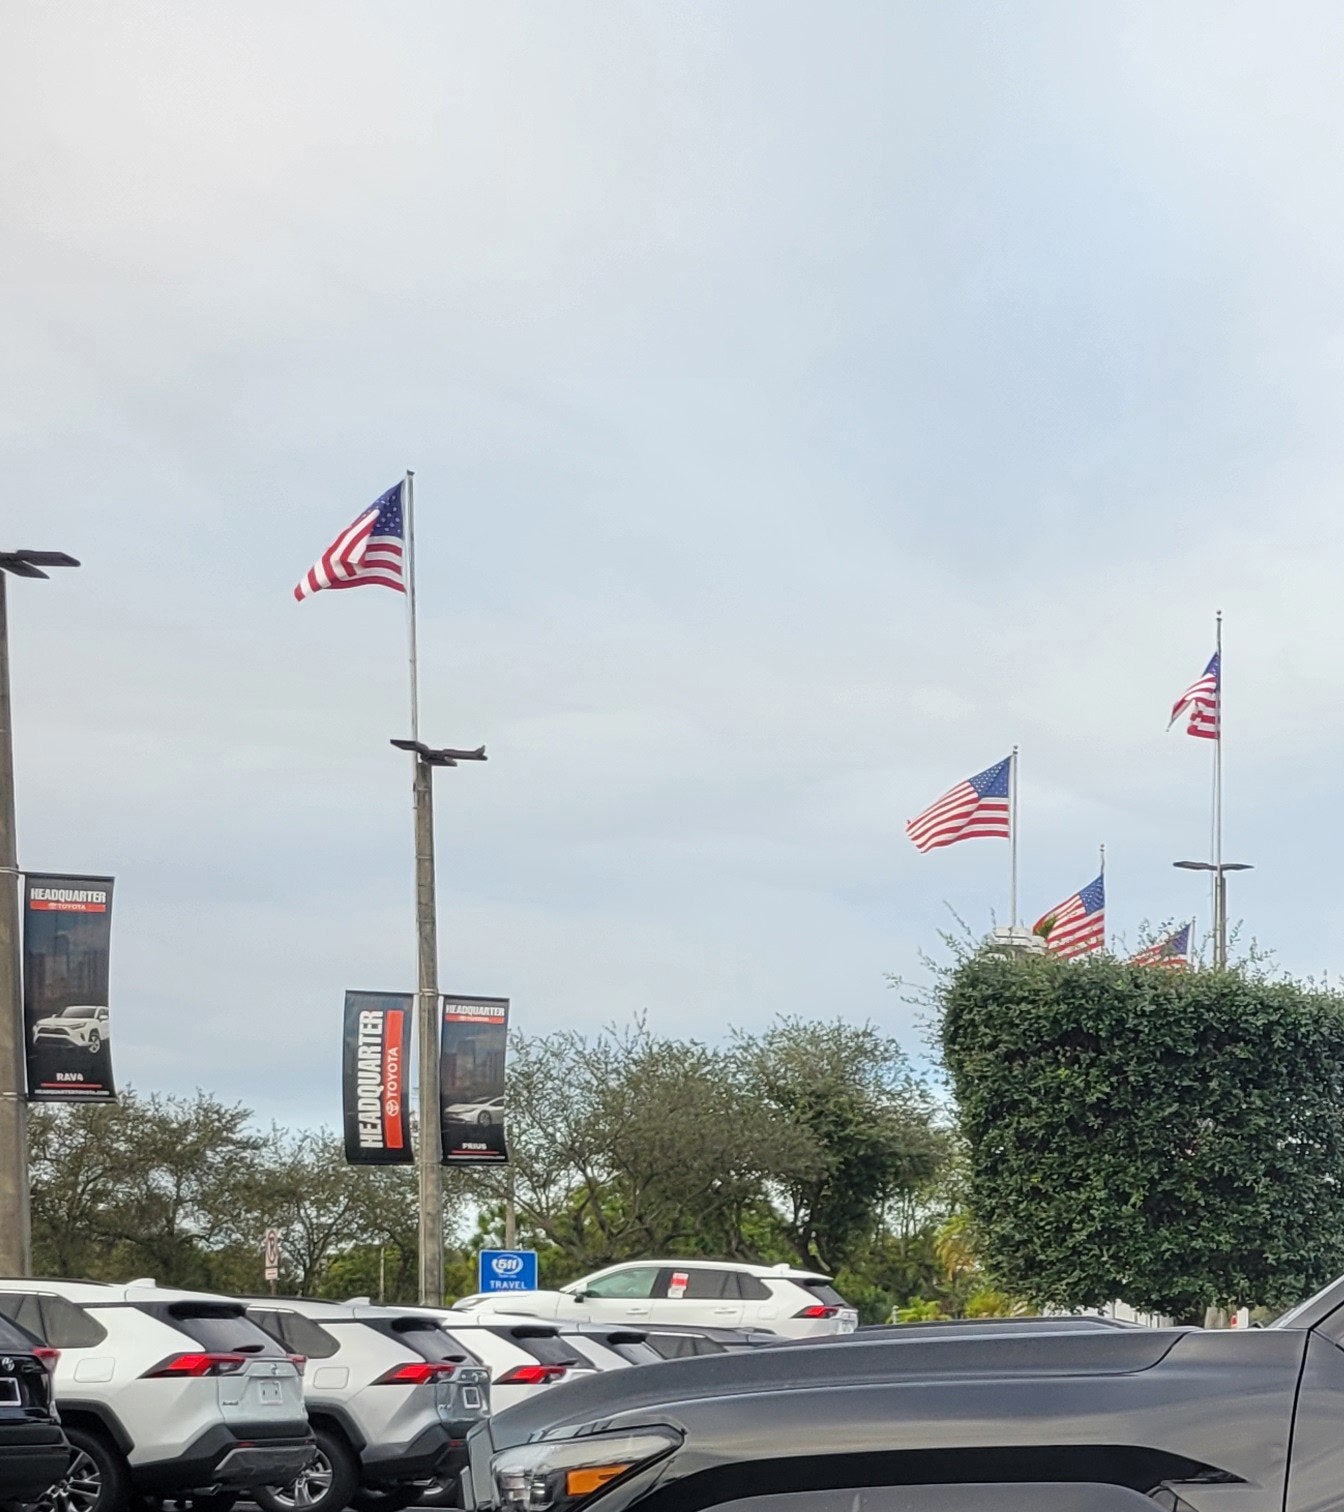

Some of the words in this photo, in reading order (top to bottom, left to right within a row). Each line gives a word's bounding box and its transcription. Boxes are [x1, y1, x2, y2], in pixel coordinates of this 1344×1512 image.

[30, 887, 106, 903] HEADQUARTER
[446, 1004, 505, 1016] HEADQUARTER
[56, 1072, 84, 1082] RAV4
[386, 1047, 399, 1098] TOYOTA
[357, 1010, 385, 1149] HEADQUARTER
[462, 1142, 487, 1150] PRIUS
[498, 1258, 518, 1270] 511
[490, 1280, 528, 1290] TRAVEL
